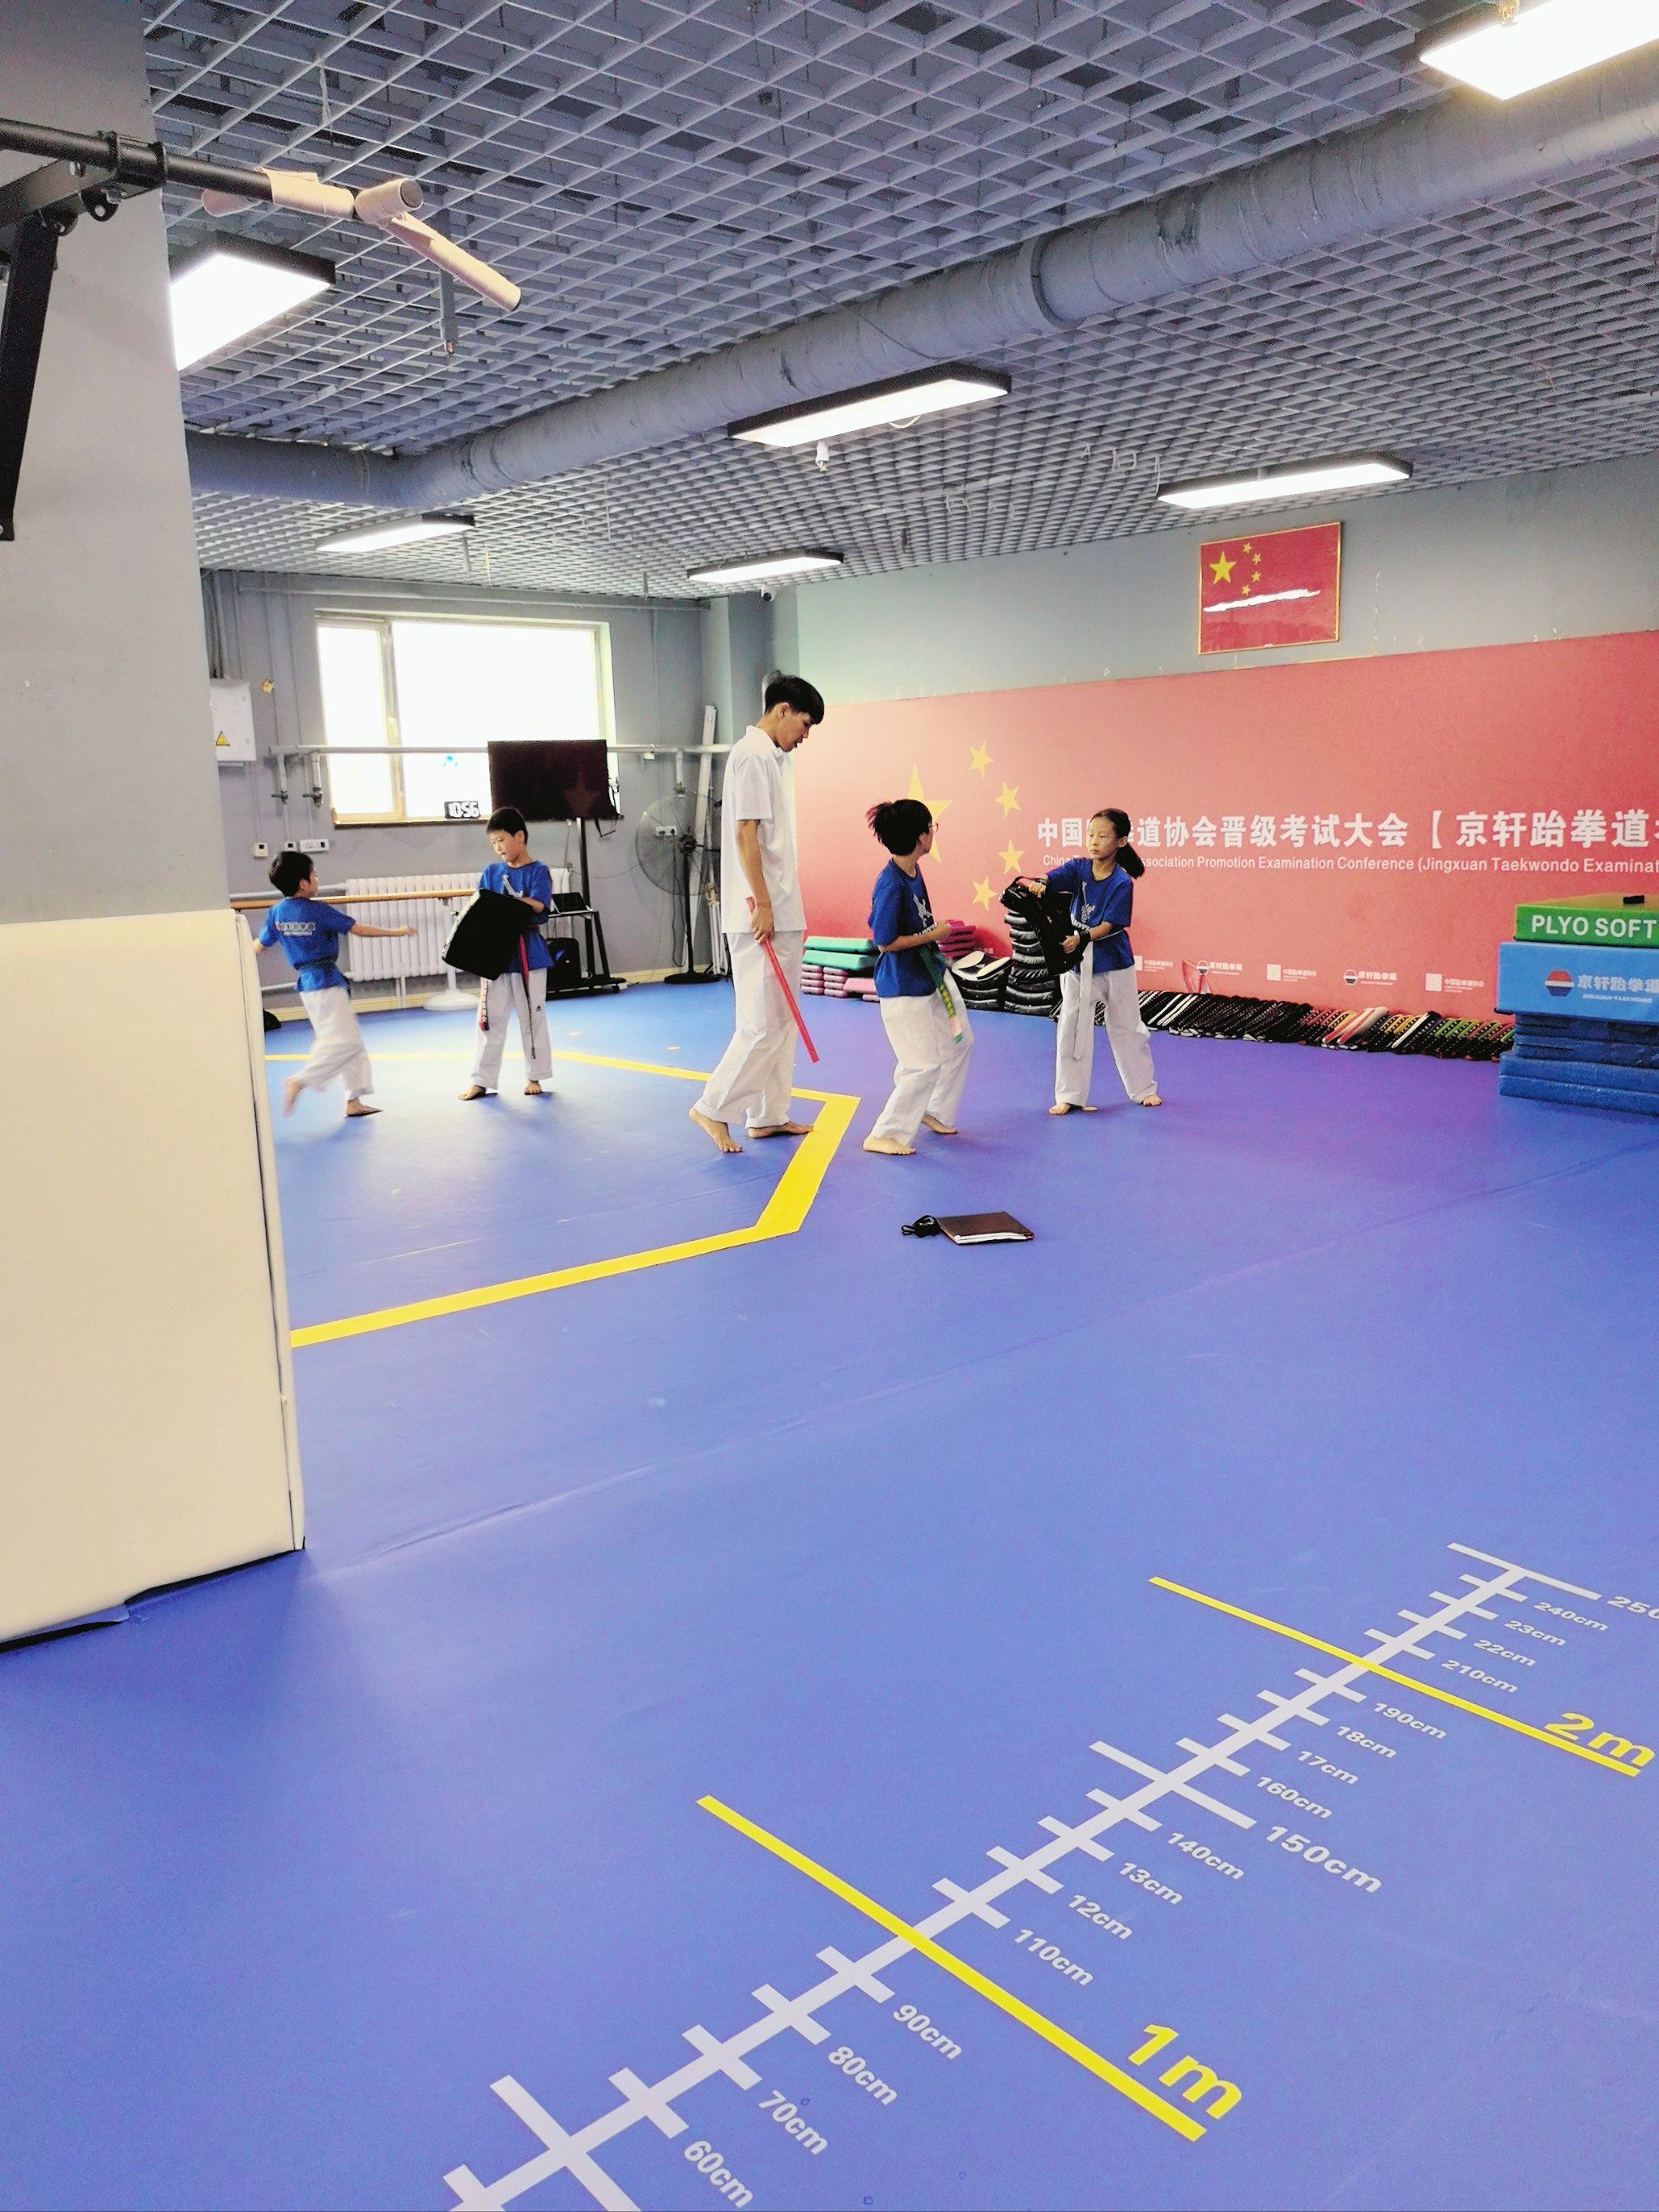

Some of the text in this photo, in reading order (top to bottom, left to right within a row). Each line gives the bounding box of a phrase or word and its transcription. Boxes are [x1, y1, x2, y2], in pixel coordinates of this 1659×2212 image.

[1196, 855, 1256, 869] Promotion
[1258, 856, 1334, 870] Examination
[1337, 856, 1414, 871] Conference
[1418, 857, 1487, 874] (Jingxuan
[1491, 857, 1580, 873] Taekwondo
[1531, 914, 1657, 939] PLYO SOFT
[1504, 1619, 1567, 1646] 23cm
[1533, 1601, 1609, 1632] 240cm
[1473, 1639, 1537, 1667] 22cm
[1440, 1660, 1519, 1693] 210cm
[1336, 1725, 1397, 1758] 18cm
[1373, 1703, 1448, 1739] 190cm
[1297, 1750, 1359, 1784] 17cm
[1256, 1775, 1333, 1818] 160cm
[1167, 1831, 1245, 1880] 140cm
[1265, 1825, 1383, 1893] 150cm
[1119, 1862, 1183, 1904] 13cm
[1068, 1894, 1133, 1939] 12cm
[1014, 1929, 1094, 1986] 110cm
[893, 2005, 962, 2060] 90cm
[828, 2046, 898, 2105] 80cm
[758, 2090, 828, 2154] 70cm
[683, 2140, 753, 2208] 60cm
